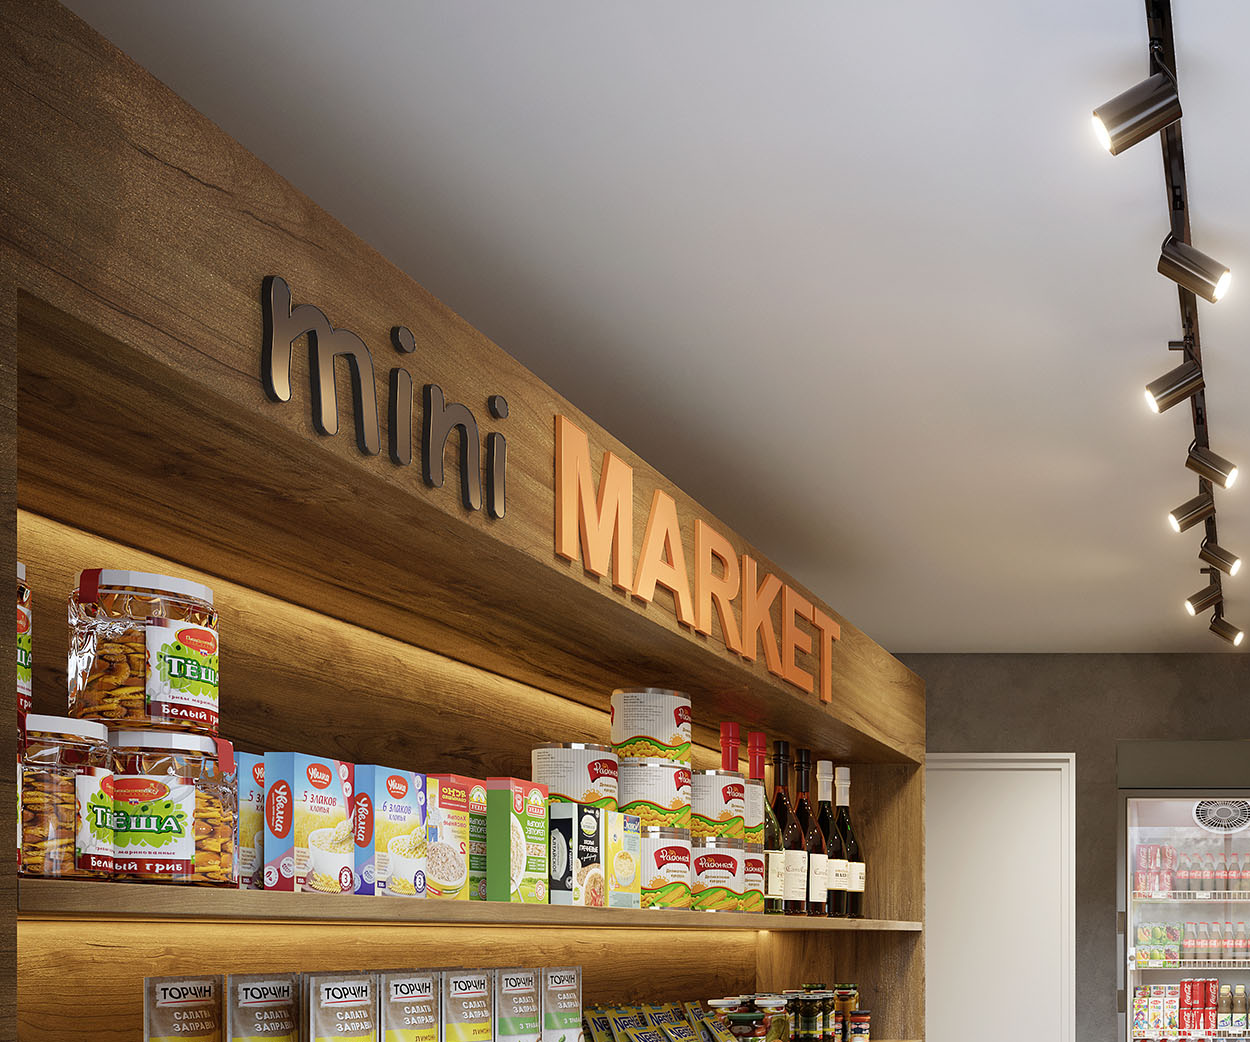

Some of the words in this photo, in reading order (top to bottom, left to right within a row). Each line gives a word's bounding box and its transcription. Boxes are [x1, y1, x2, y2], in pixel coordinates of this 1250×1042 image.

[262, 275, 508, 519] mini
[555, 414, 841, 703] MARKET
[161, 704, 206, 723] Белый
[303, 790, 308, 802] 5
[145, 861, 183, 874] гриб
[161, 985, 212, 1000] ТОРЧИН
[242, 985, 290, 1000] ТОРЧИН
[324, 985, 368, 1000] ТОРЧИН
[393, 981, 431, 996] ТОРЧИН
[453, 979, 486, 992] ТОРЧИН
